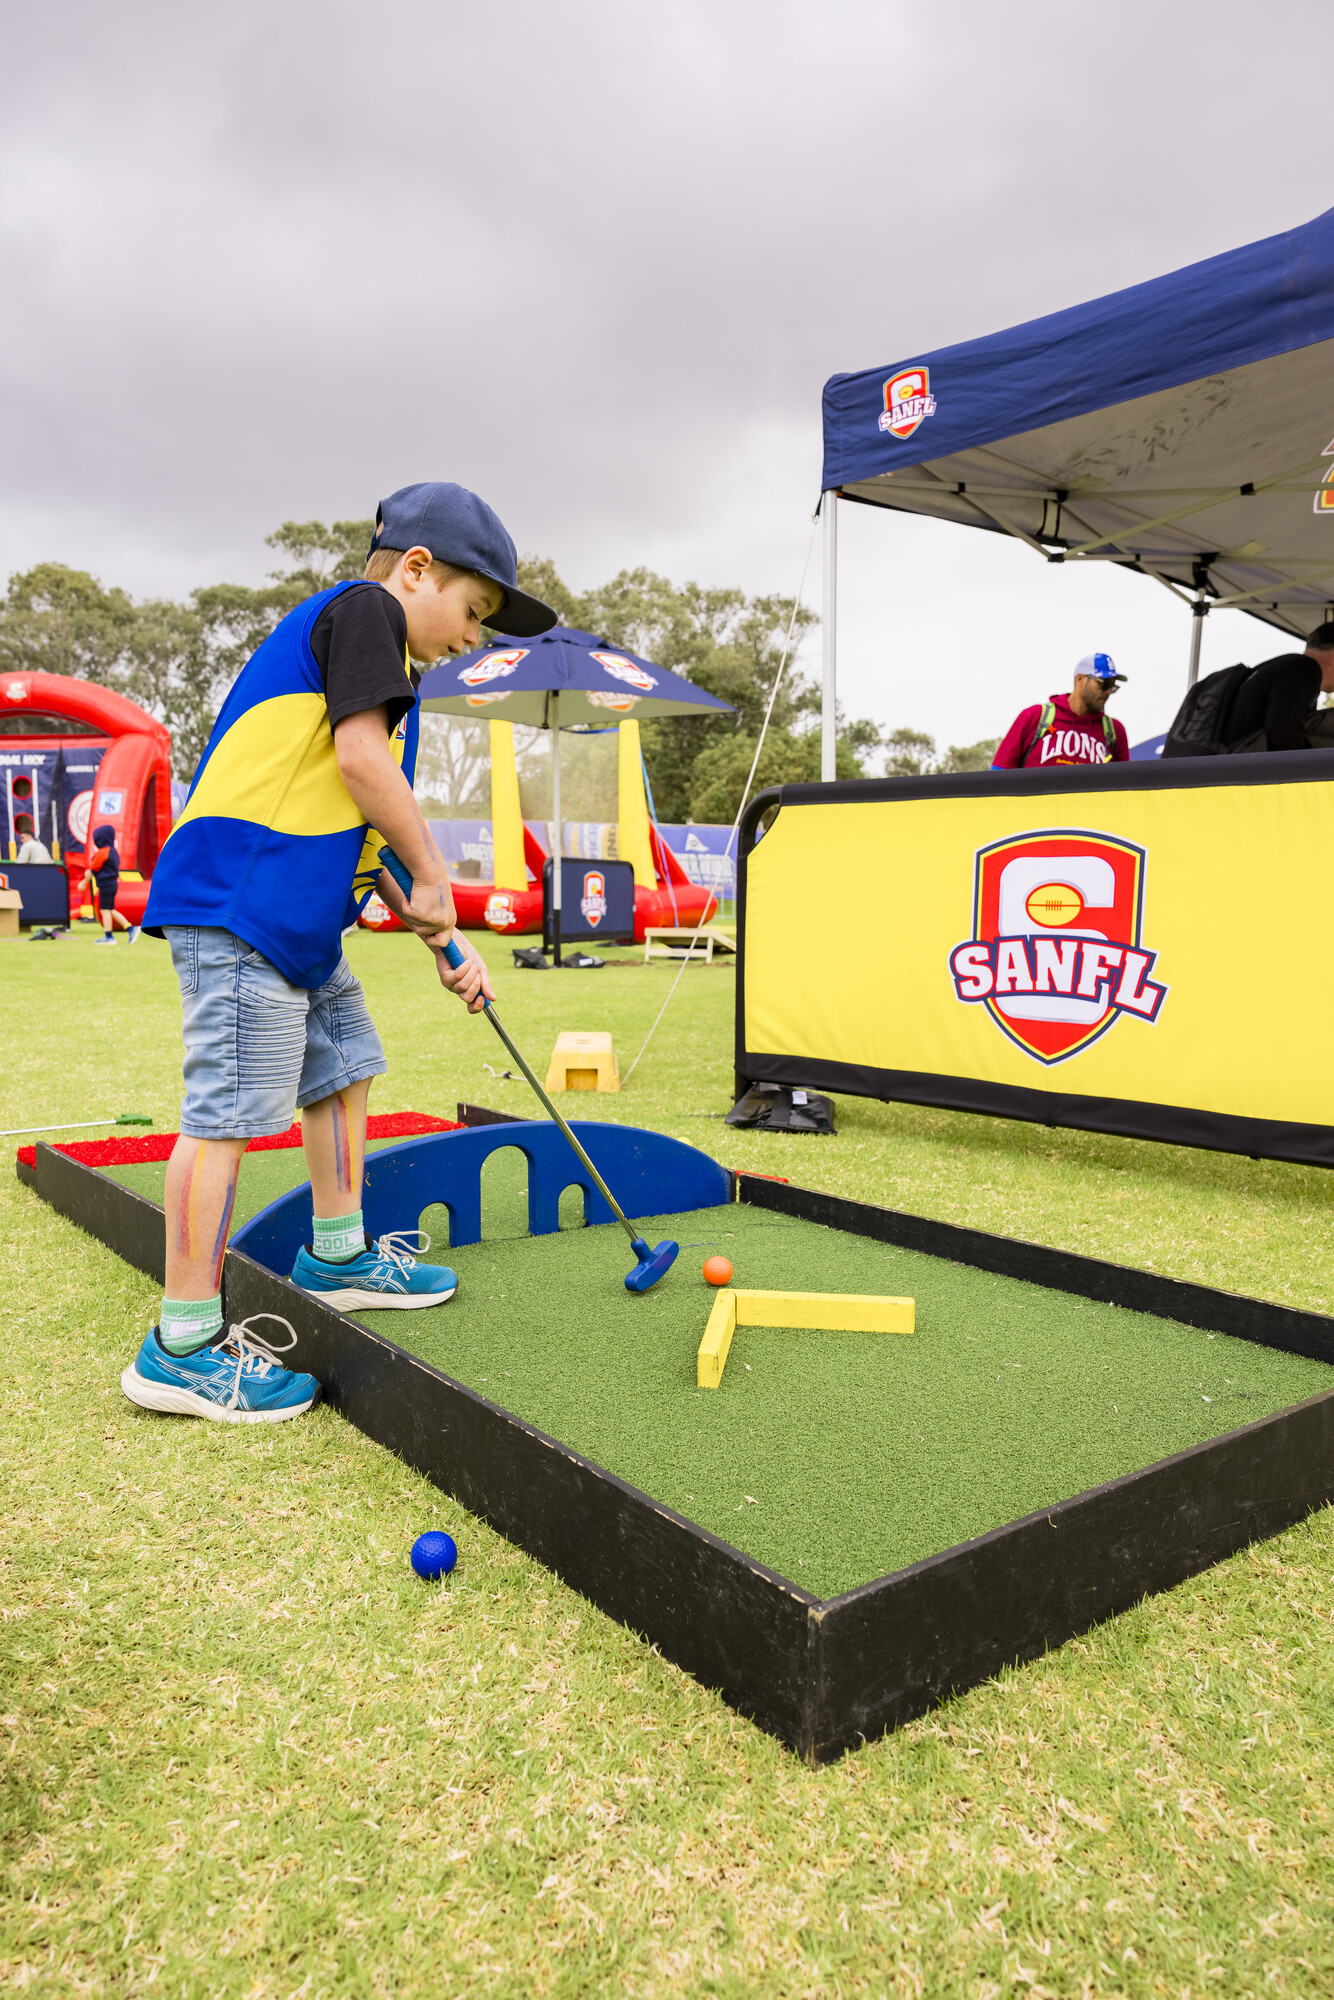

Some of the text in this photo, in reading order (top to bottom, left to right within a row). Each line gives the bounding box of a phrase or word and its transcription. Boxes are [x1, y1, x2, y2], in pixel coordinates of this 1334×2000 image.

[880, 396, 936, 430] SANFL
[1040, 729, 1108, 765] LIONS
[952, 937, 1163, 1018] SANFL
[313, 1236, 354, 1252] COOL
